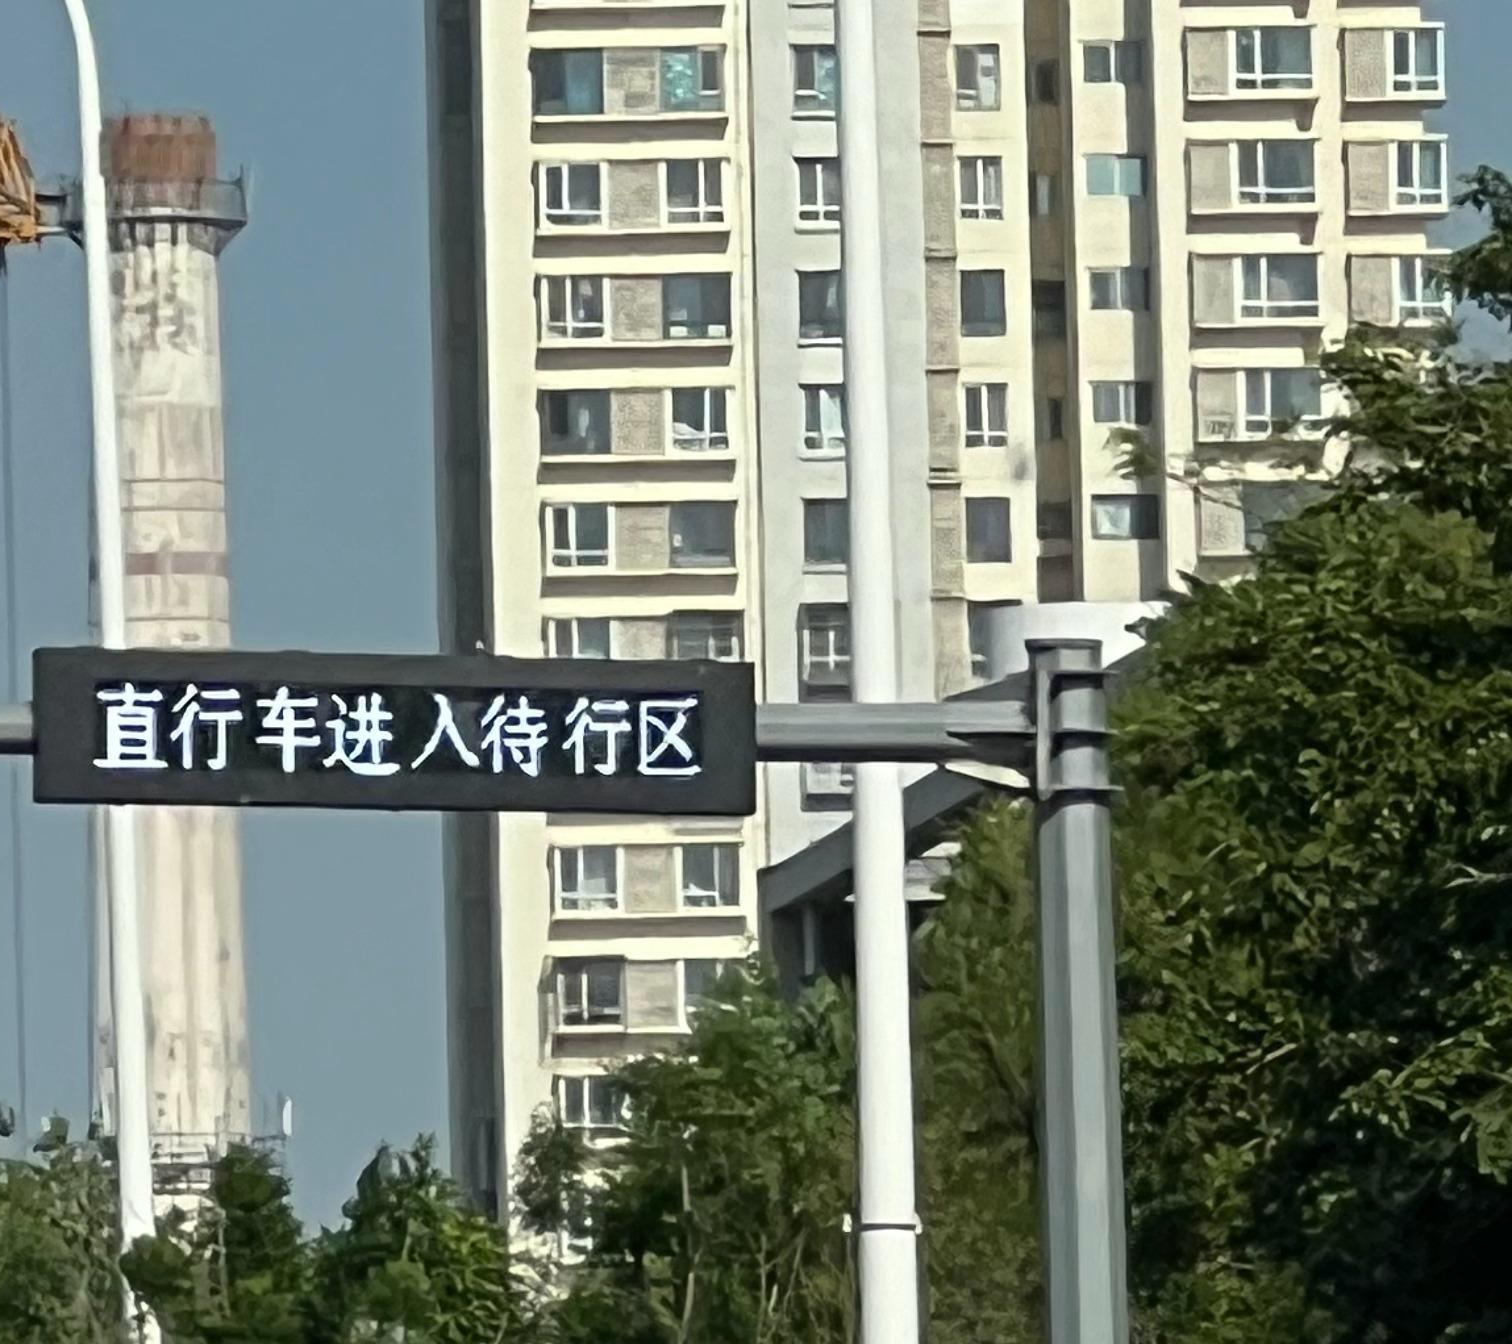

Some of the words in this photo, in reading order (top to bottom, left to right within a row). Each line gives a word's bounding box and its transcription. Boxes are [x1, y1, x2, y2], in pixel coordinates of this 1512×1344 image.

[93, 684, 702, 777] 直行车进入待行区
